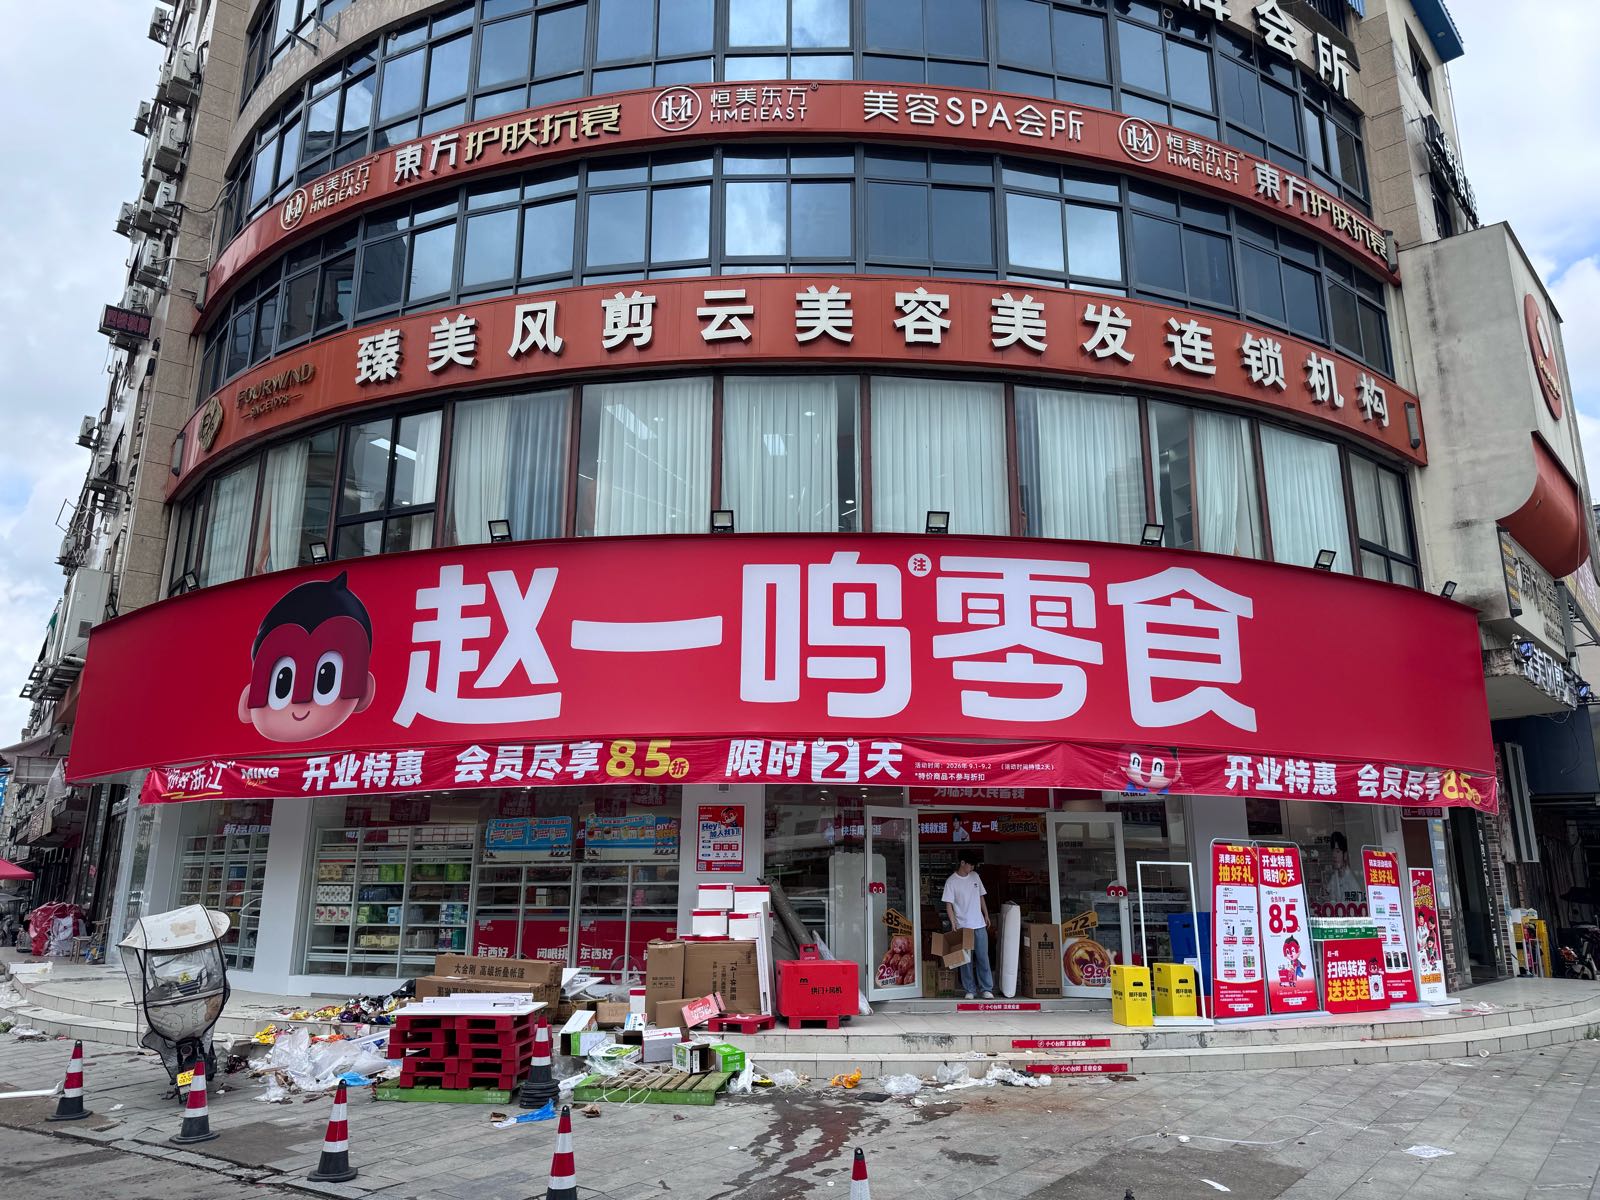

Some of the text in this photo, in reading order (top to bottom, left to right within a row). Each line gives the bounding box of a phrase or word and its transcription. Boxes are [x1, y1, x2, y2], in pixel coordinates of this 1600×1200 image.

[710, 87, 807, 107] 恒美东方
[710, 106, 807, 122] HMEIEAST
[863, 90, 1084, 141] 美容SPA会所
[394, 104, 621, 183] 東方护肤抗衰
[1167, 132, 1238, 171] 恒美东方
[312, 162, 372, 199] 恒美东方
[1168, 152, 1239, 183] HMEIEAST
[310, 180, 369, 213] HMEIEAST
[1254, 162, 1388, 260] 東方护肤抗衰
[355, 285, 1391, 427] 臻美风剪云美容美发连锁机构
[391, 550, 1257, 733] 赵一鸣零食
[241, 767, 280, 779] MING
[302, 750, 426, 792] 开业特惠
[725, 737, 903, 783] 限时2天
[1224, 754, 1338, 796] 开业特惠
[1218, 864, 1254, 883] 抽好礼
[1261, 855, 1294, 868] 开业特惠
[1263, 868, 1295, 885] 限时2天
[1369, 869, 1396, 884] 送好礼
[477, 947, 509, 958] 东西好
[580, 948, 614, 960] 东西好
[1327, 960, 1367, 978] 扫码转发
[1328, 977, 1370, 1002] 送送送
